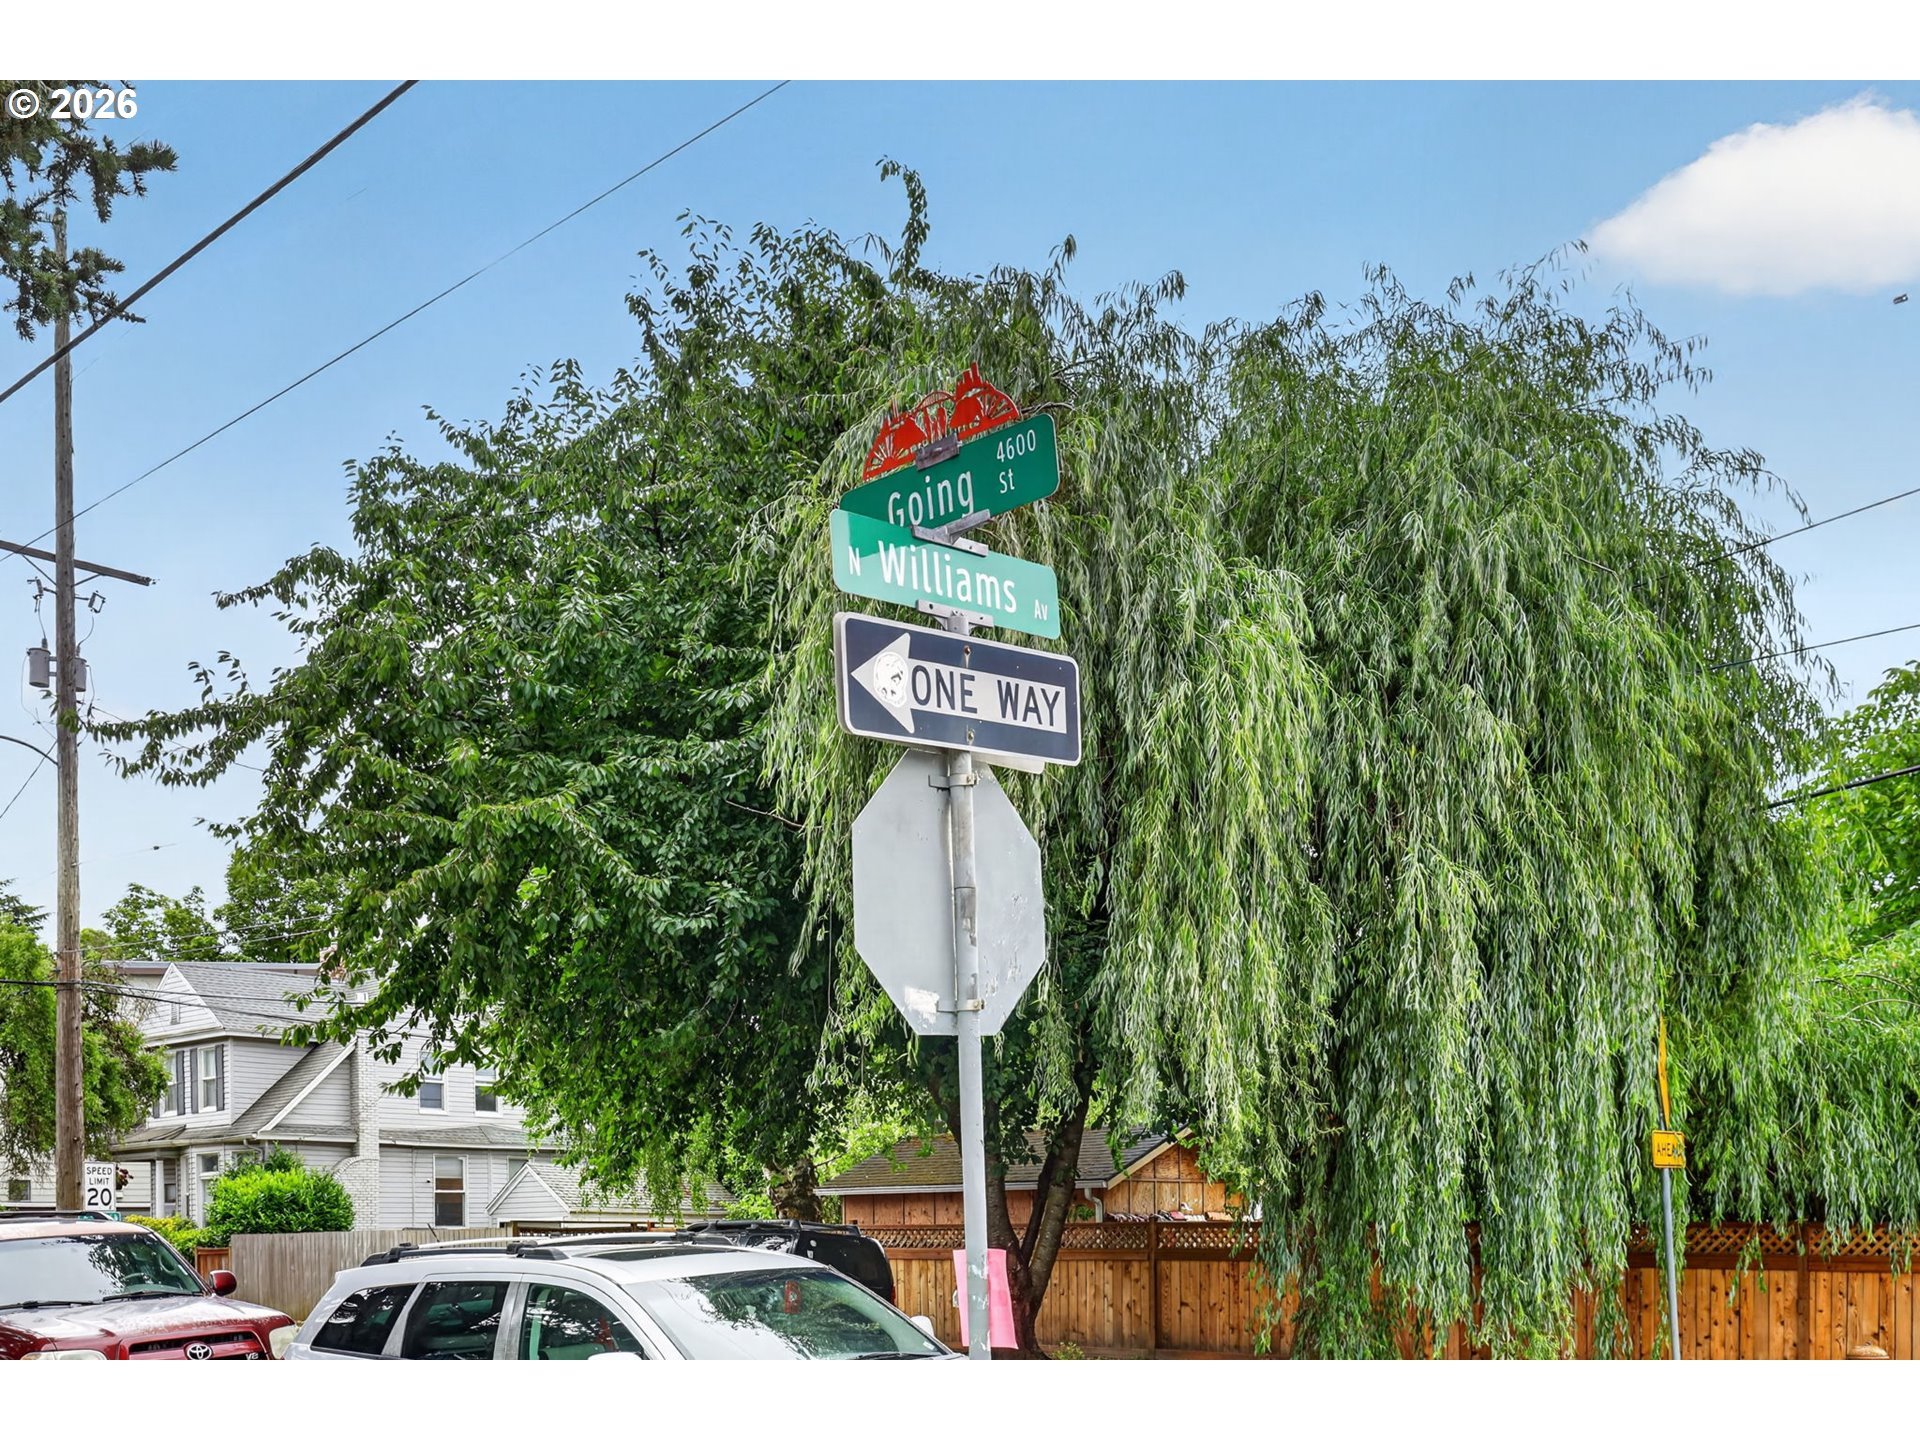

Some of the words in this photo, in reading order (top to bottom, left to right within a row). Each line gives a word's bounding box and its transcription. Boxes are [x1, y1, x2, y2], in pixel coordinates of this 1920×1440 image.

[996, 429, 1037, 463] 4600
[888, 471, 975, 528] Going
[999, 468, 1015, 495] St
[848, 545, 862, 577] N
[878, 540, 1017, 614] Williams
[911, 664, 978, 714] ONE
[997, 679, 1060, 727] WAY
[86, 1166, 112, 1175] SPEED
[87, 1188, 112, 1206] 20
